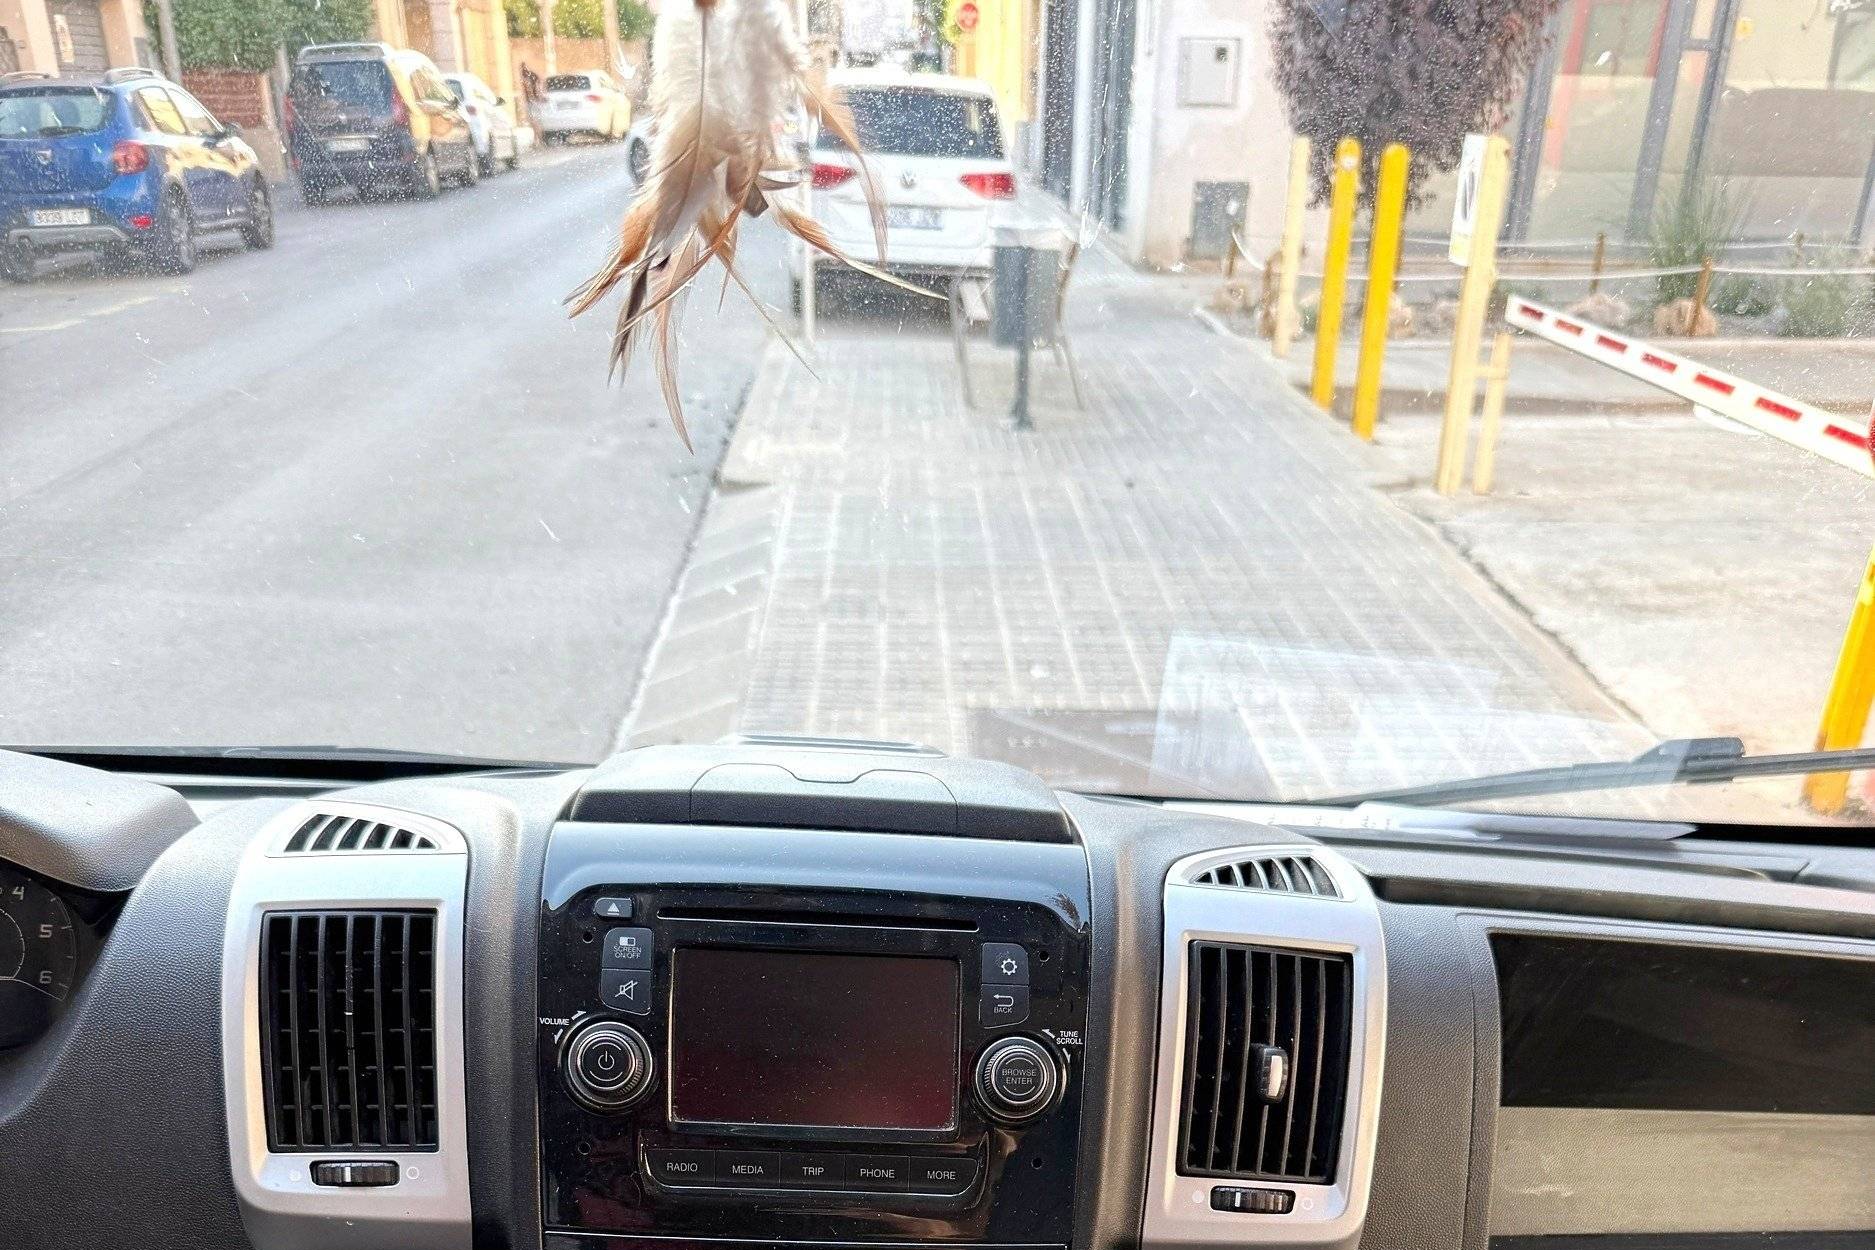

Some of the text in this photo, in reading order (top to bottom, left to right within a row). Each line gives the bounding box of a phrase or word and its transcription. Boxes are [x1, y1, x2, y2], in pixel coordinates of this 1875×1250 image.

[12, 886, 25, 900] 4
[39, 924, 54, 938] 5
[613, 945, 642, 954] SCREEN
[39, 971, 53, 984] 6
[539, 1017, 570, 1026] VOLUME
[1060, 1030, 1079, 1038] TUNE
[1056, 1037, 1083, 1045] SCROLL
[1001, 1068, 1037, 1077] BROWSE
[1005, 1076, 1033, 1085] ENTER
[666, 1162, 698, 1173] RADIO
[732, 1165, 764, 1175] MEDIA
[802, 1166, 825, 1176] TRIP
[860, 1168, 895, 1179] PHONE
[927, 1170, 956, 1180] MORE
